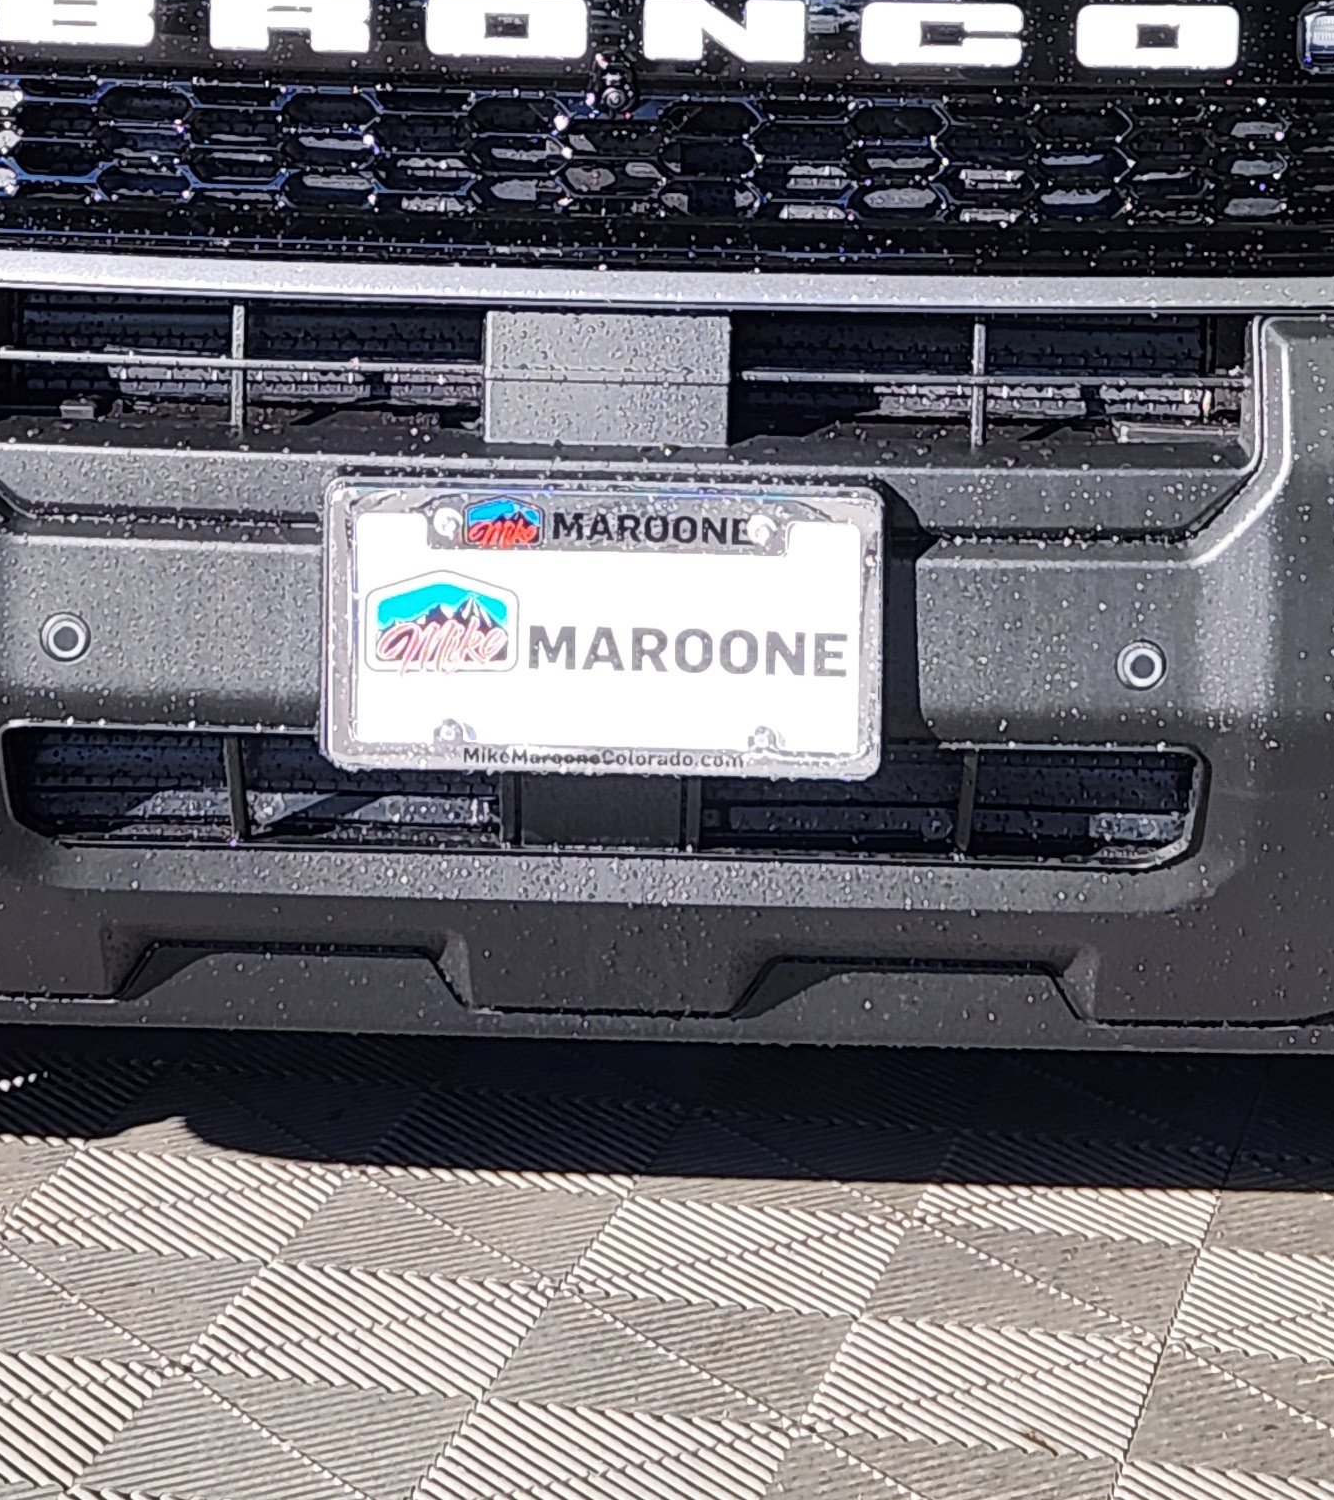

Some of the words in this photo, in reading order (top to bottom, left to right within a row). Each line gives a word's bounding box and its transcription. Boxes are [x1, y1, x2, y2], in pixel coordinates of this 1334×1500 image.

[468, 520, 538, 548] Mike
[376, 618, 509, 677] Mike
[529, 625, 848, 678] MAROONE
[463, 747, 744, 768] MikeMarooneColorado.com
